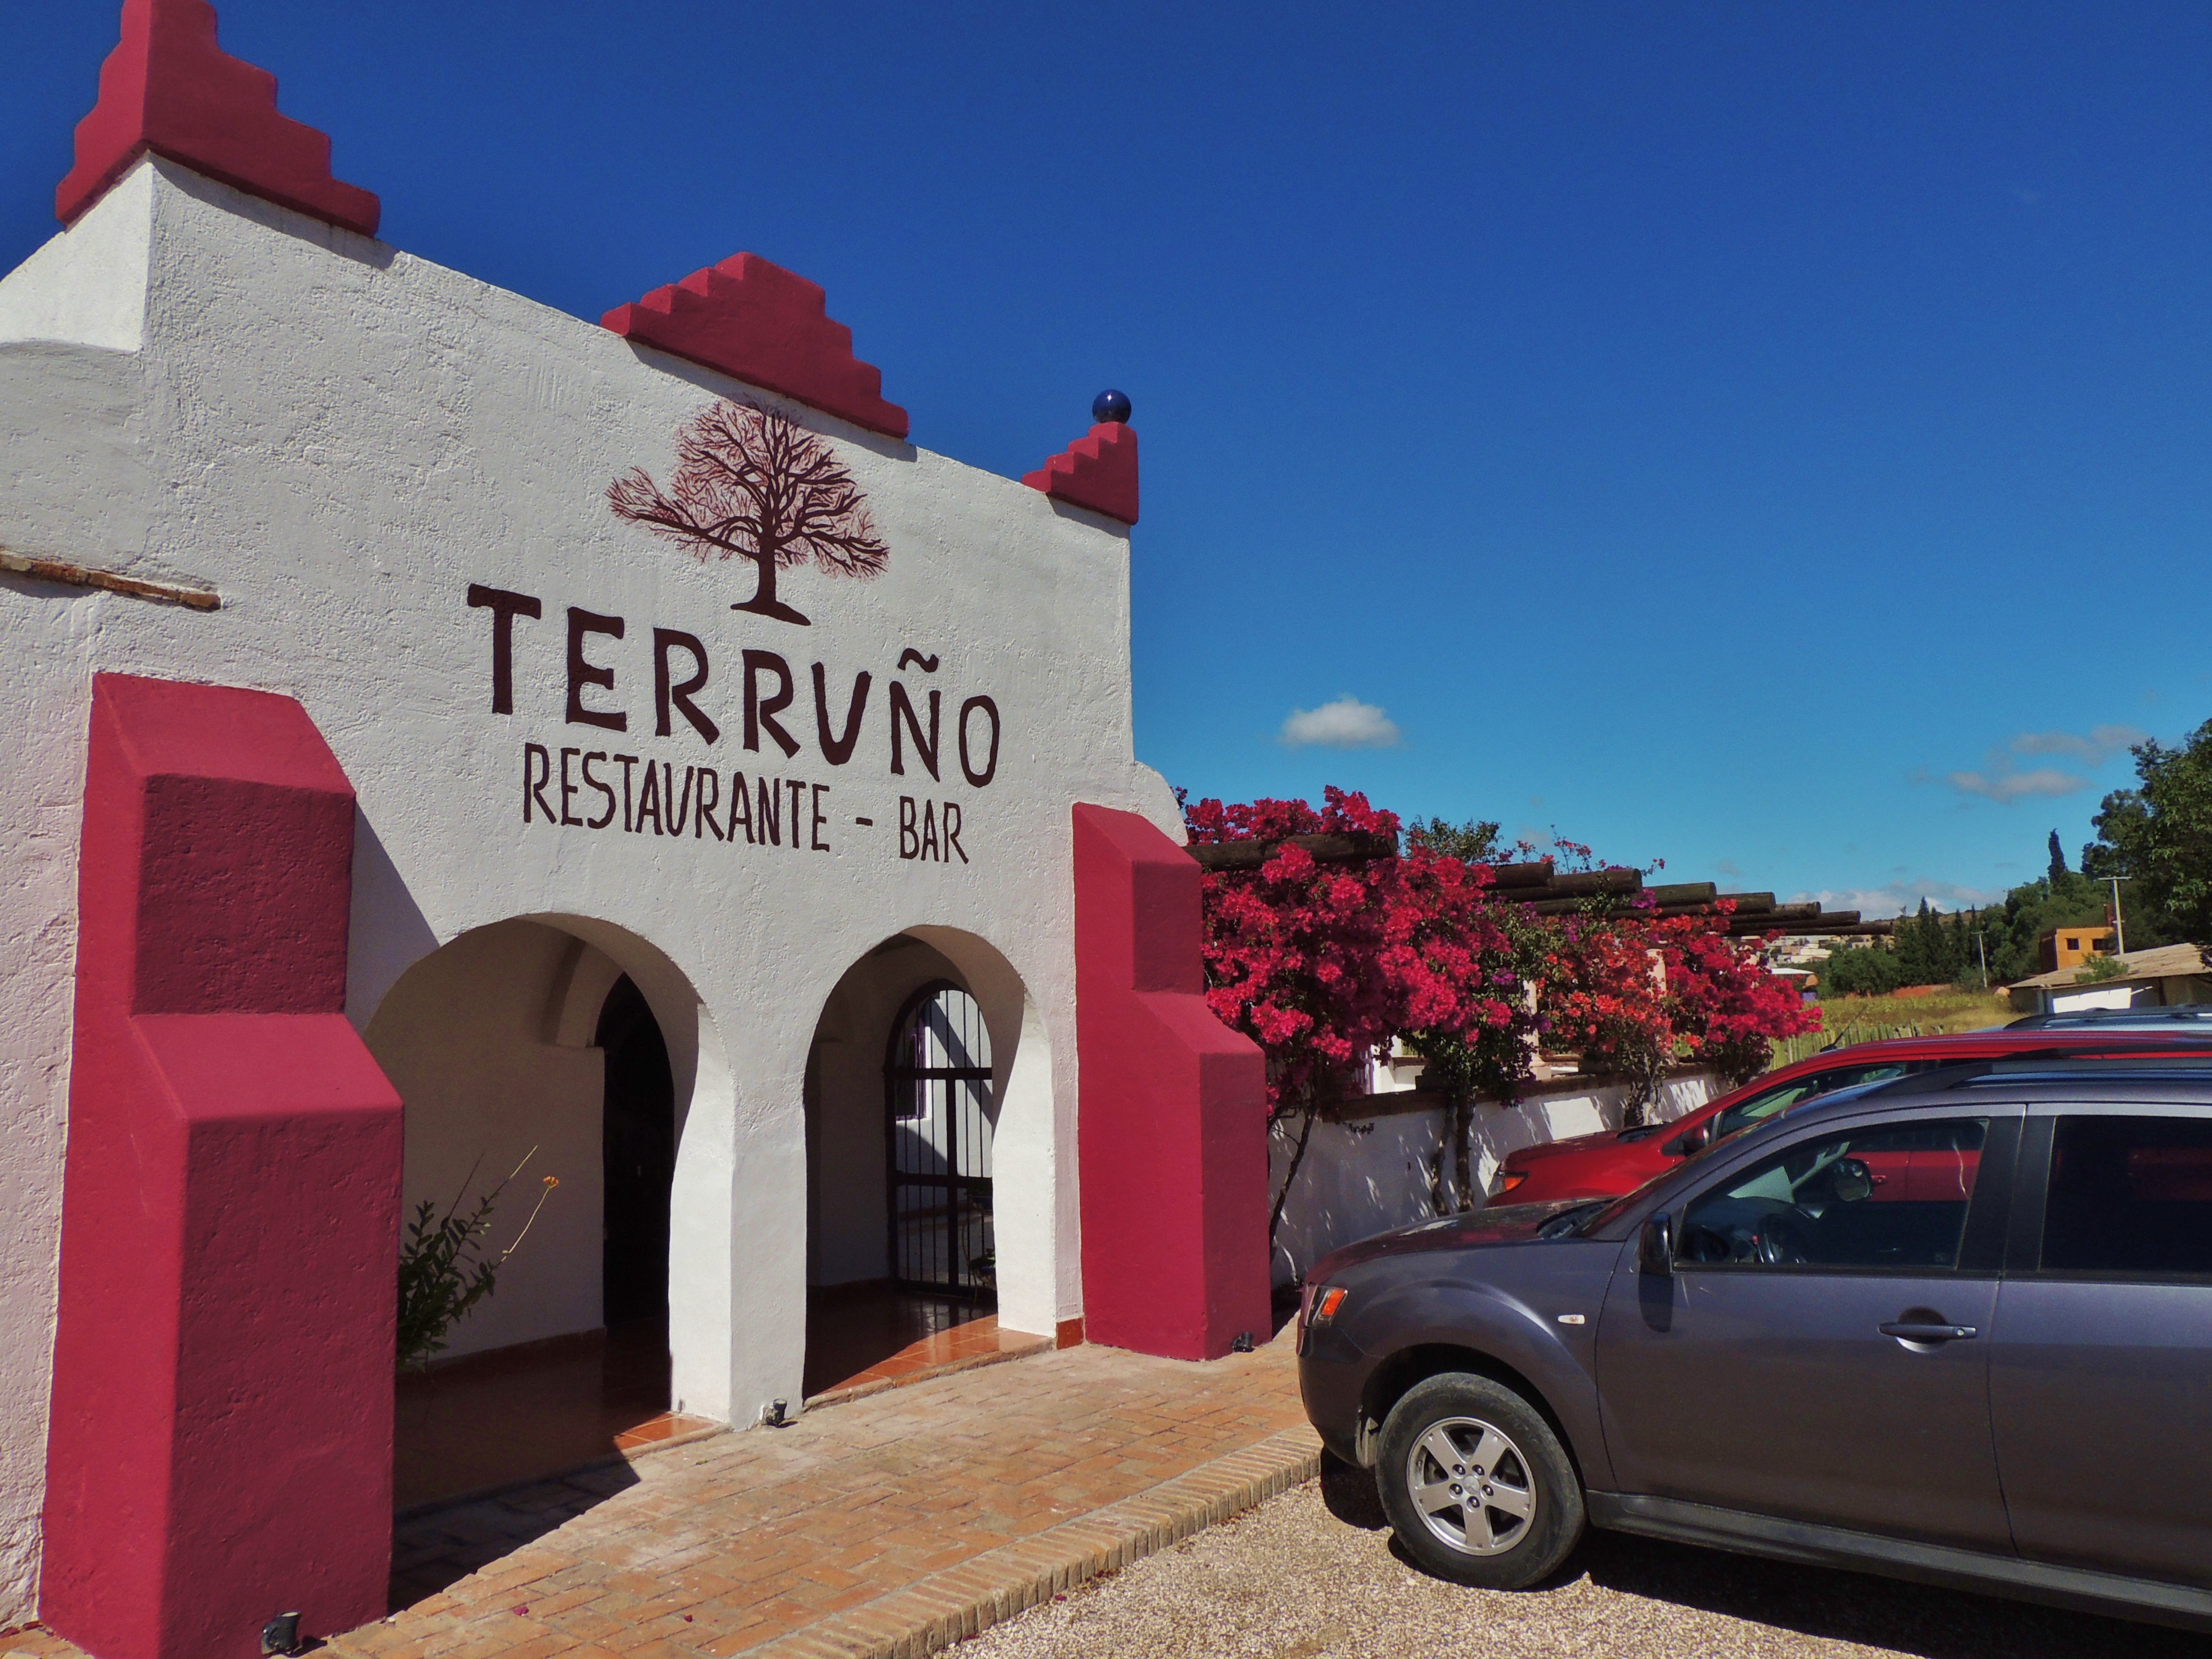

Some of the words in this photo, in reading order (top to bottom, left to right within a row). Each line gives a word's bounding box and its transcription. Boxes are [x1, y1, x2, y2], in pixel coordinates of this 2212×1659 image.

[467, 583, 1000, 788] TERRUÑO
[523, 742, 830, 853] RESTAURANTE
[899, 795, 969, 865] BAR
